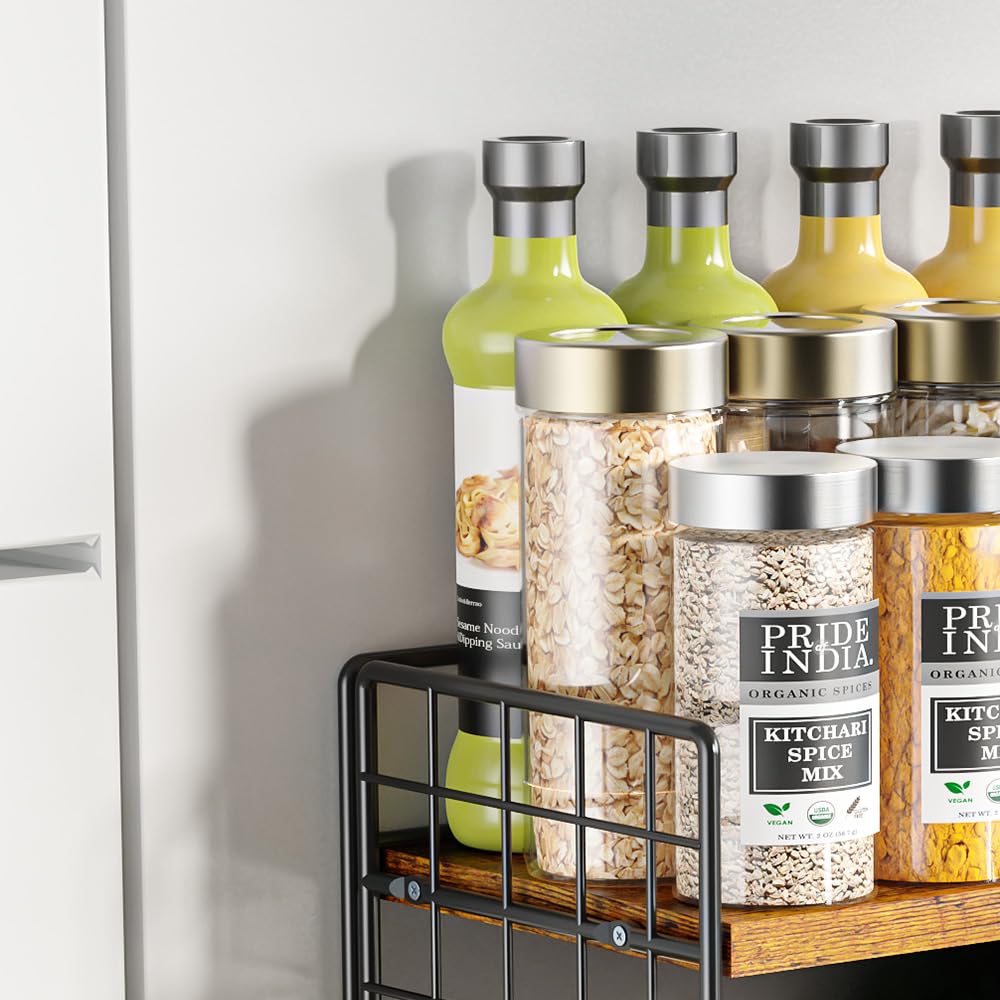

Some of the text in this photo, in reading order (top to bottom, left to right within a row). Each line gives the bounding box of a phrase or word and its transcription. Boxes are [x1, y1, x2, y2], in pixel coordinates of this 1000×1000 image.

[761, 617, 869, 649] PRIDE
[748, 681, 872, 698] ORGANIC SPICES
[764, 720, 868, 741] KITCHARI
[788, 743, 852, 762] SPICE
[801, 765, 844, 782] MIX
